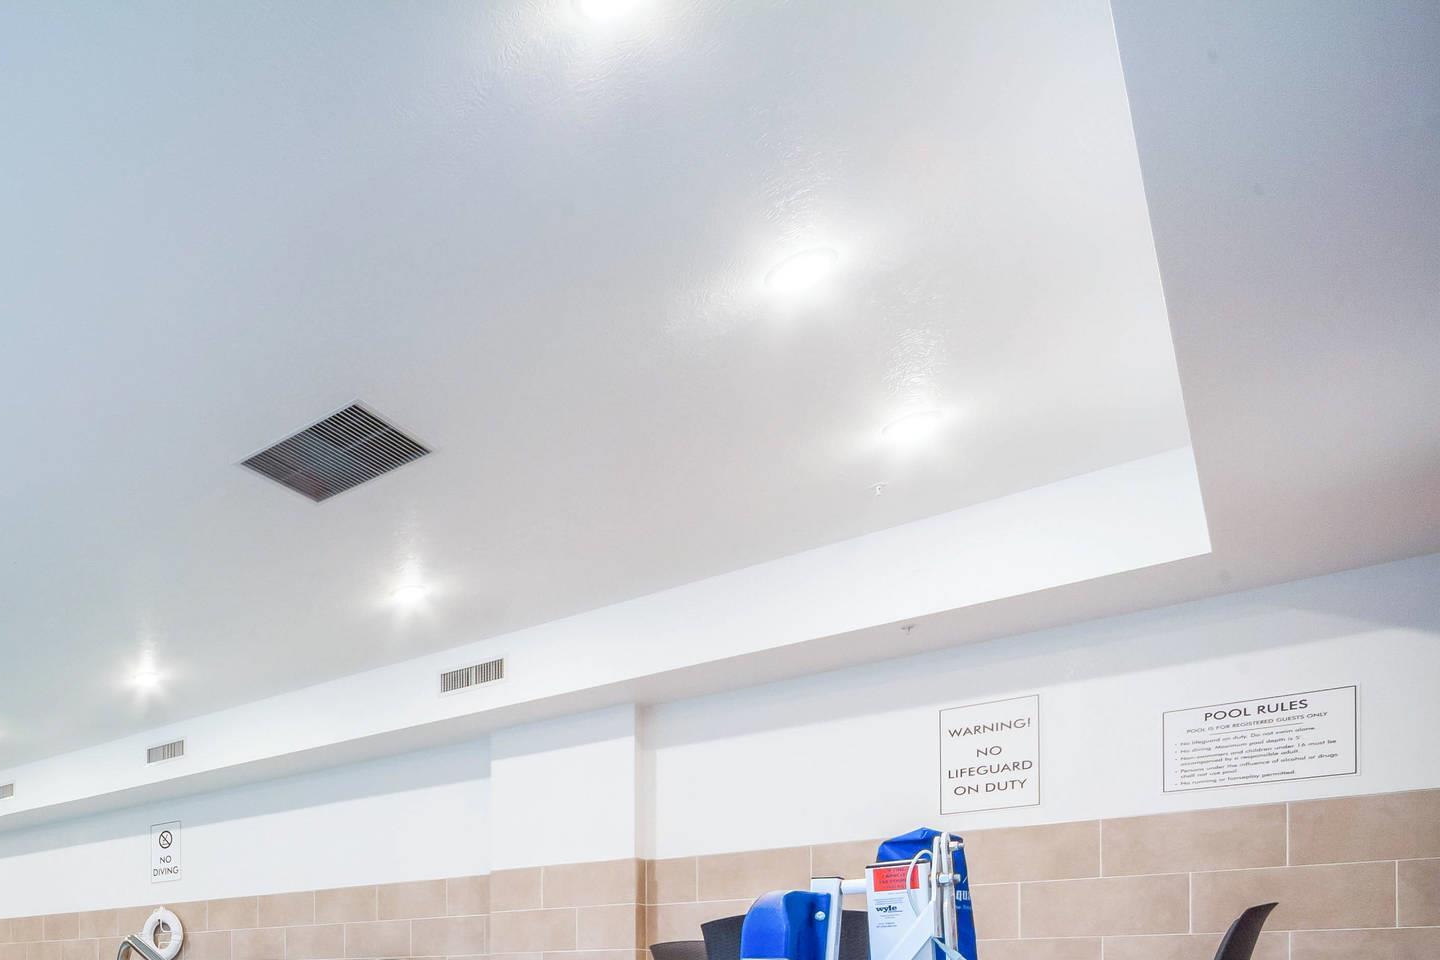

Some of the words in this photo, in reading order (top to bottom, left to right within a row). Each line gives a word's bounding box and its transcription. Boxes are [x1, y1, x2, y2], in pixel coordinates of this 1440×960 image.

[1204, 707, 1251, 721] POOL
[1257, 699, 1309, 714] RULES
[948, 717, 1031, 738] WARNING!
[1231, 719, 1273, 727] REGISTERED
[976, 745, 1003, 758] NO
[948, 760, 1033, 779] LIFEGUARD
[953, 784, 980, 796] ON
[985, 778, 1027, 793] DUTY
[160, 855, 172, 864] NO
[153, 866, 179, 877] DIVING
